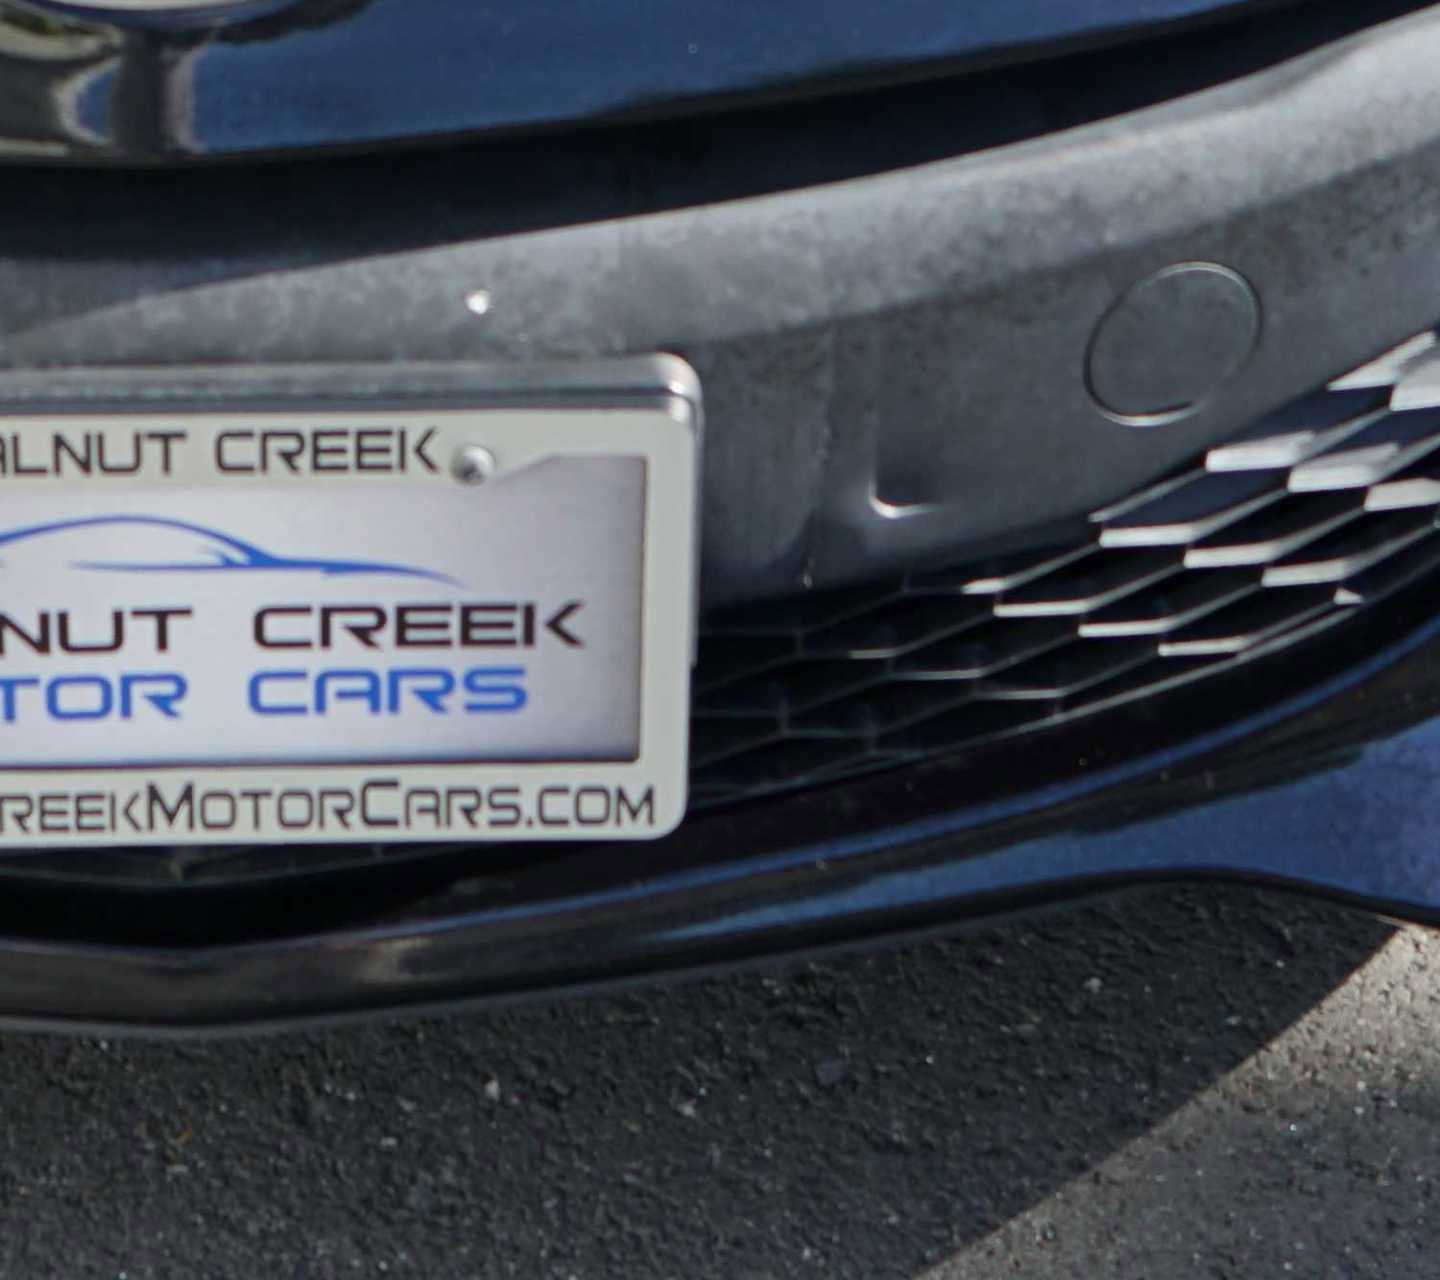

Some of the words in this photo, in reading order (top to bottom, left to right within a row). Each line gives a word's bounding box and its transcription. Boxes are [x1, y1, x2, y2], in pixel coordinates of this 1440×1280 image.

[214, 427, 438, 474] CREEK
[252, 600, 586, 649] CREEK
[246, 664, 530, 717] CARS
